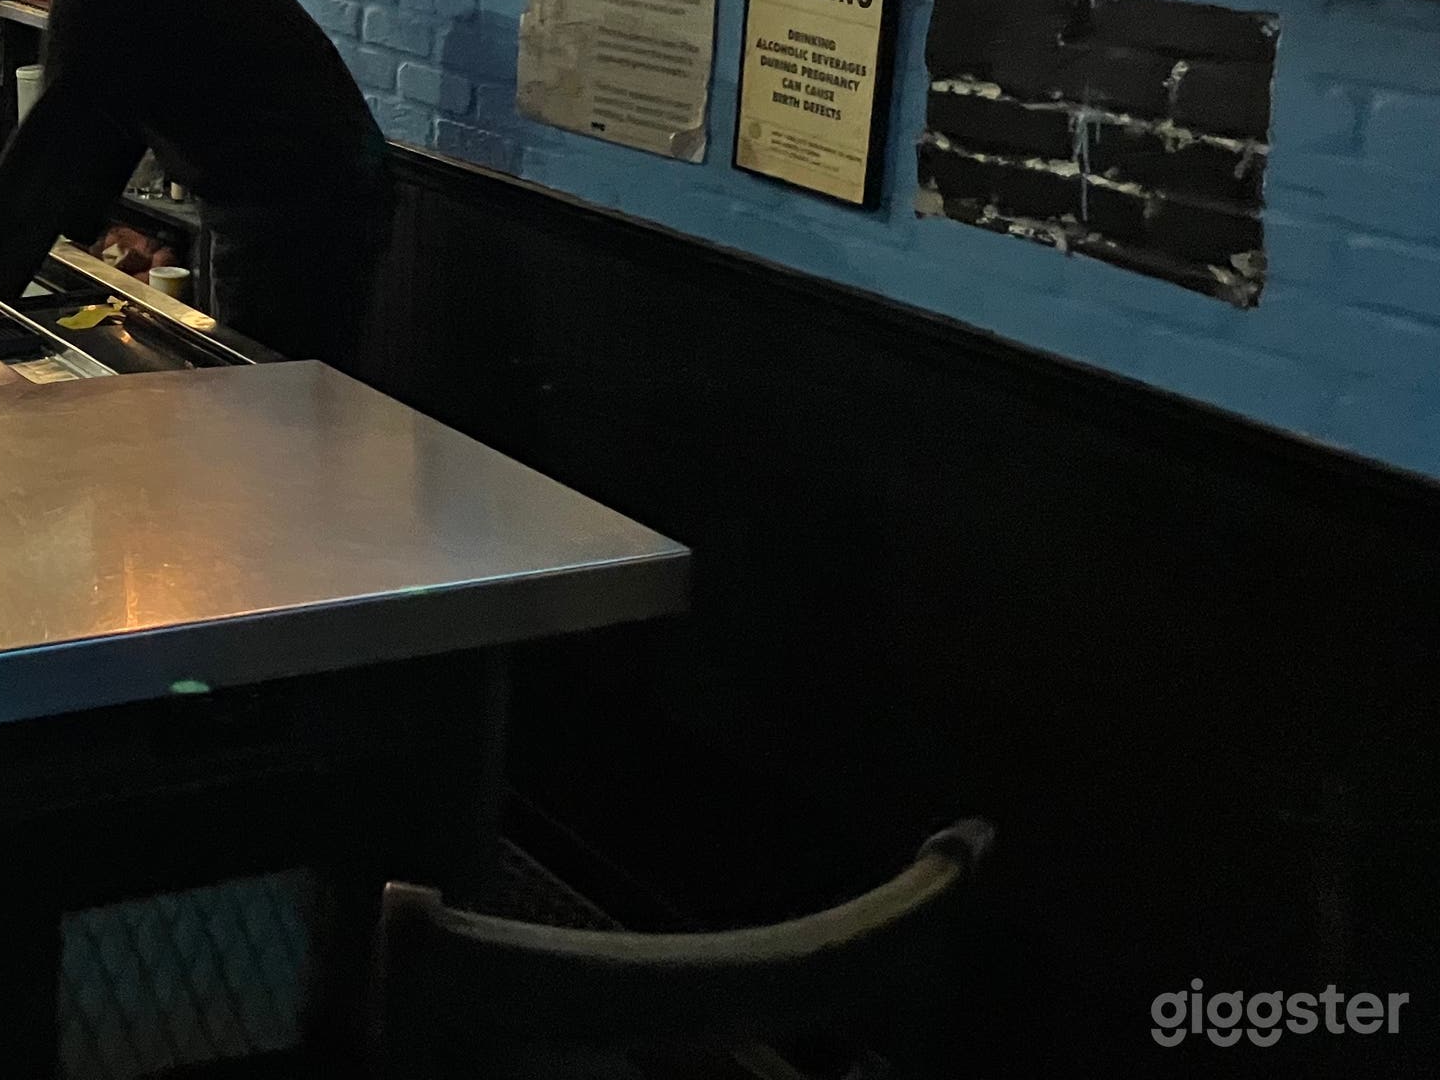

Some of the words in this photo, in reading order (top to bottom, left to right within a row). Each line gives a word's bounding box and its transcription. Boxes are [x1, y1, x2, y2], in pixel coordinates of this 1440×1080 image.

[788, 29, 836, 51] DRINKING
[756, 38, 808, 62] ALCOHOLIC
[811, 51, 867, 77] BEVERAGES
[760, 54, 799, 75] DURING
[801, 63, 860, 92] PREGNANCY
[782, 77, 802, 92] CAN
[805, 83, 834, 102] CAUSE
[772, 91, 800, 109] BIRTH
[803, 98, 842, 121] DEFECTS
